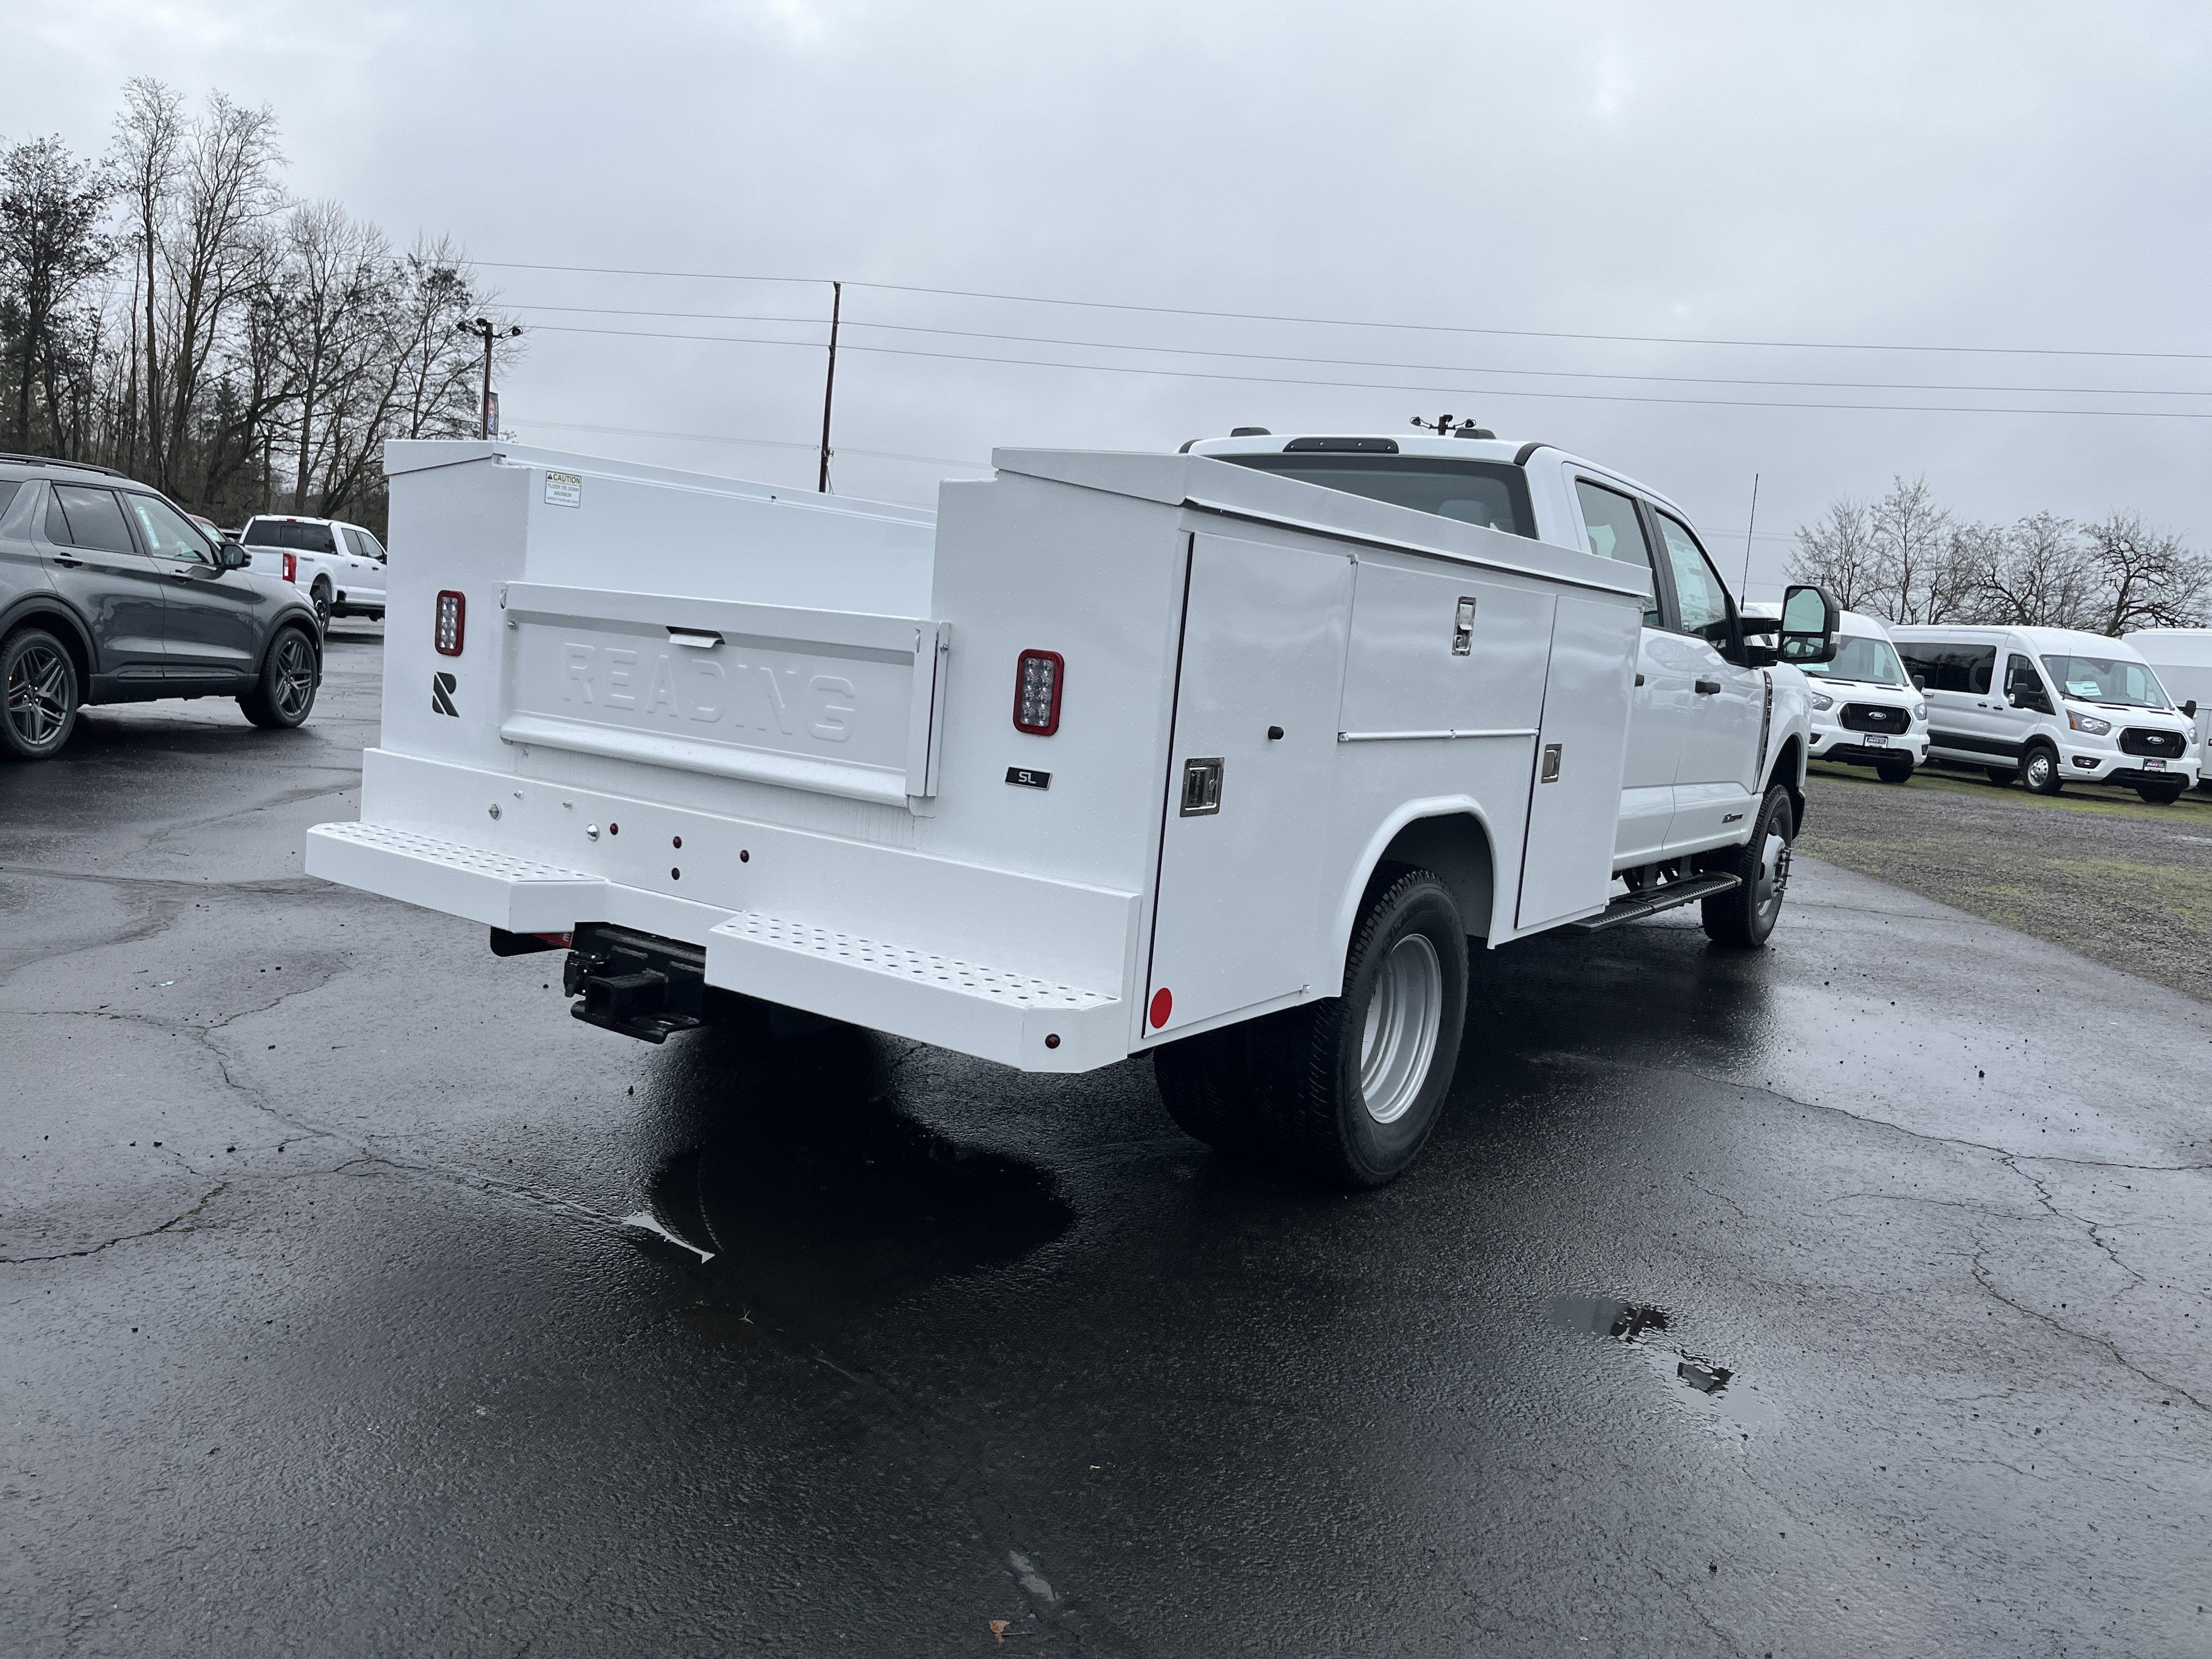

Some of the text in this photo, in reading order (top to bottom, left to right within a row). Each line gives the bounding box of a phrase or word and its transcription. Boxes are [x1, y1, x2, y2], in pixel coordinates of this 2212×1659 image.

[553, 473, 580, 484] CAUTION
[563, 642, 855, 743] READING
[1018, 771, 1037, 785] SL
